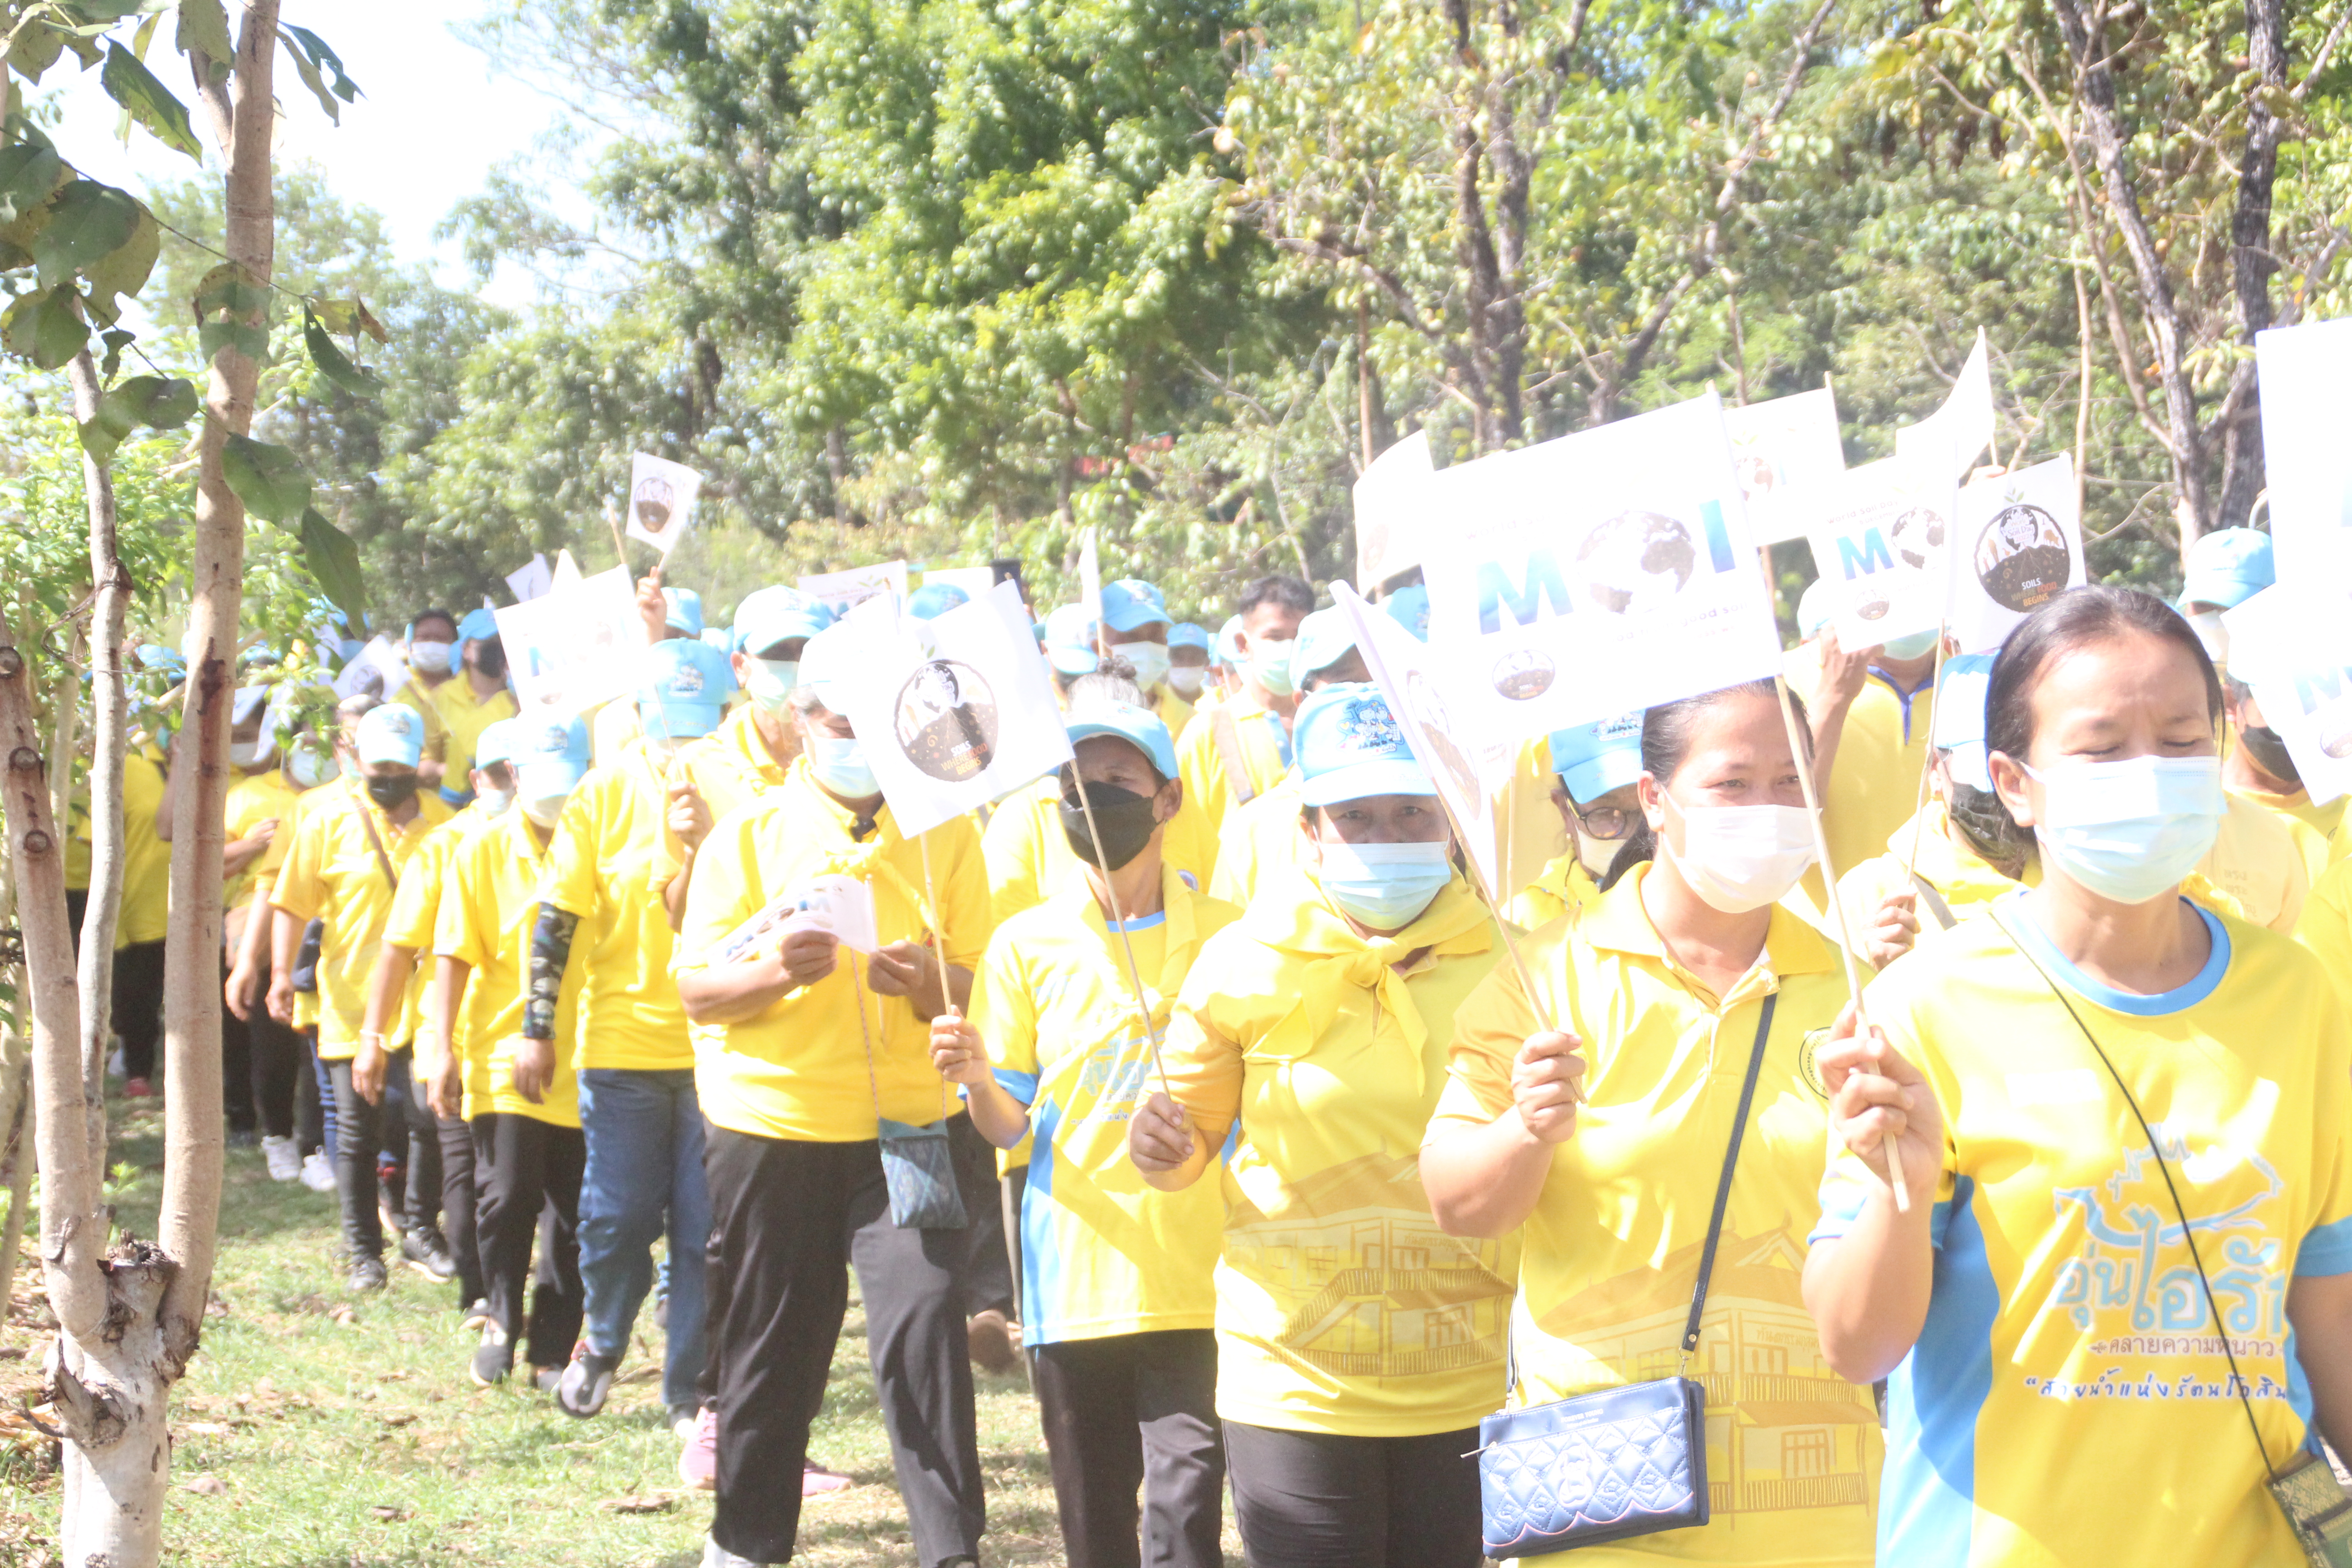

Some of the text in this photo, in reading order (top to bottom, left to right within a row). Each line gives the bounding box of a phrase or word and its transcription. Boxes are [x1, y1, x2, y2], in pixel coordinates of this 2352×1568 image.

[1826, 500, 1899, 524] World Soil Day
[1464, 519, 1517, 540] World
[1524, 514, 1551, 525] So
[2007, 525, 2034, 537] Soil Day
[2022, 578, 2041, 590] SOILS
[2037, 581, 2057, 593] FOOD
[2023, 593, 2049, 606] BEGINS
[1680, 607, 1718, 627] good
[1722, 601, 1748, 614] soil
[941, 743, 988, 771] WHERE FOOD
[951, 740, 971, 757] SOILS
[955, 756, 981, 775] BEGINS
[1561, 1408, 1603, 1422] FOREVER YOUNG
